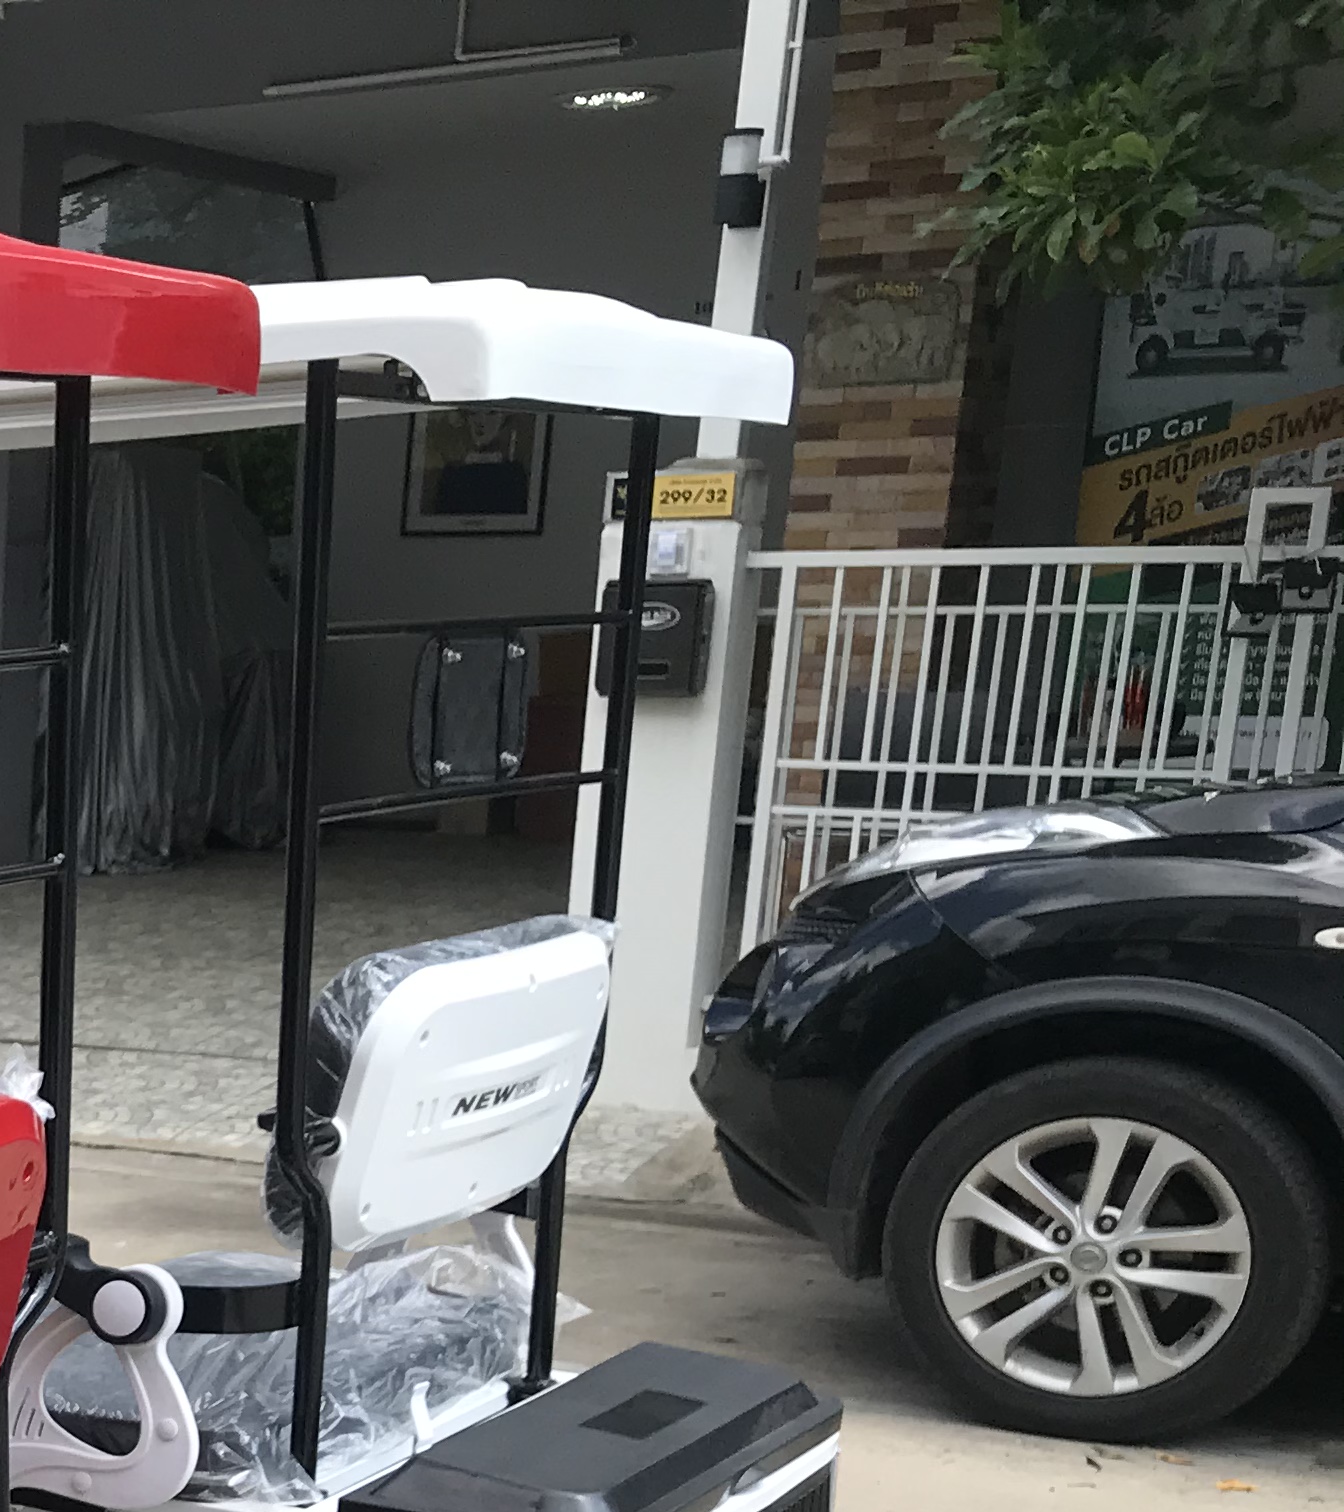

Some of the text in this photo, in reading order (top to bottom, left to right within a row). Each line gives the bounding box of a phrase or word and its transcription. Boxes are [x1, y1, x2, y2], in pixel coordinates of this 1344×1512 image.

[1104, 414, 1209, 457] CLP Car
[660, 487, 727, 505] 299/32
[452, 1083, 516, 1116] NEW
